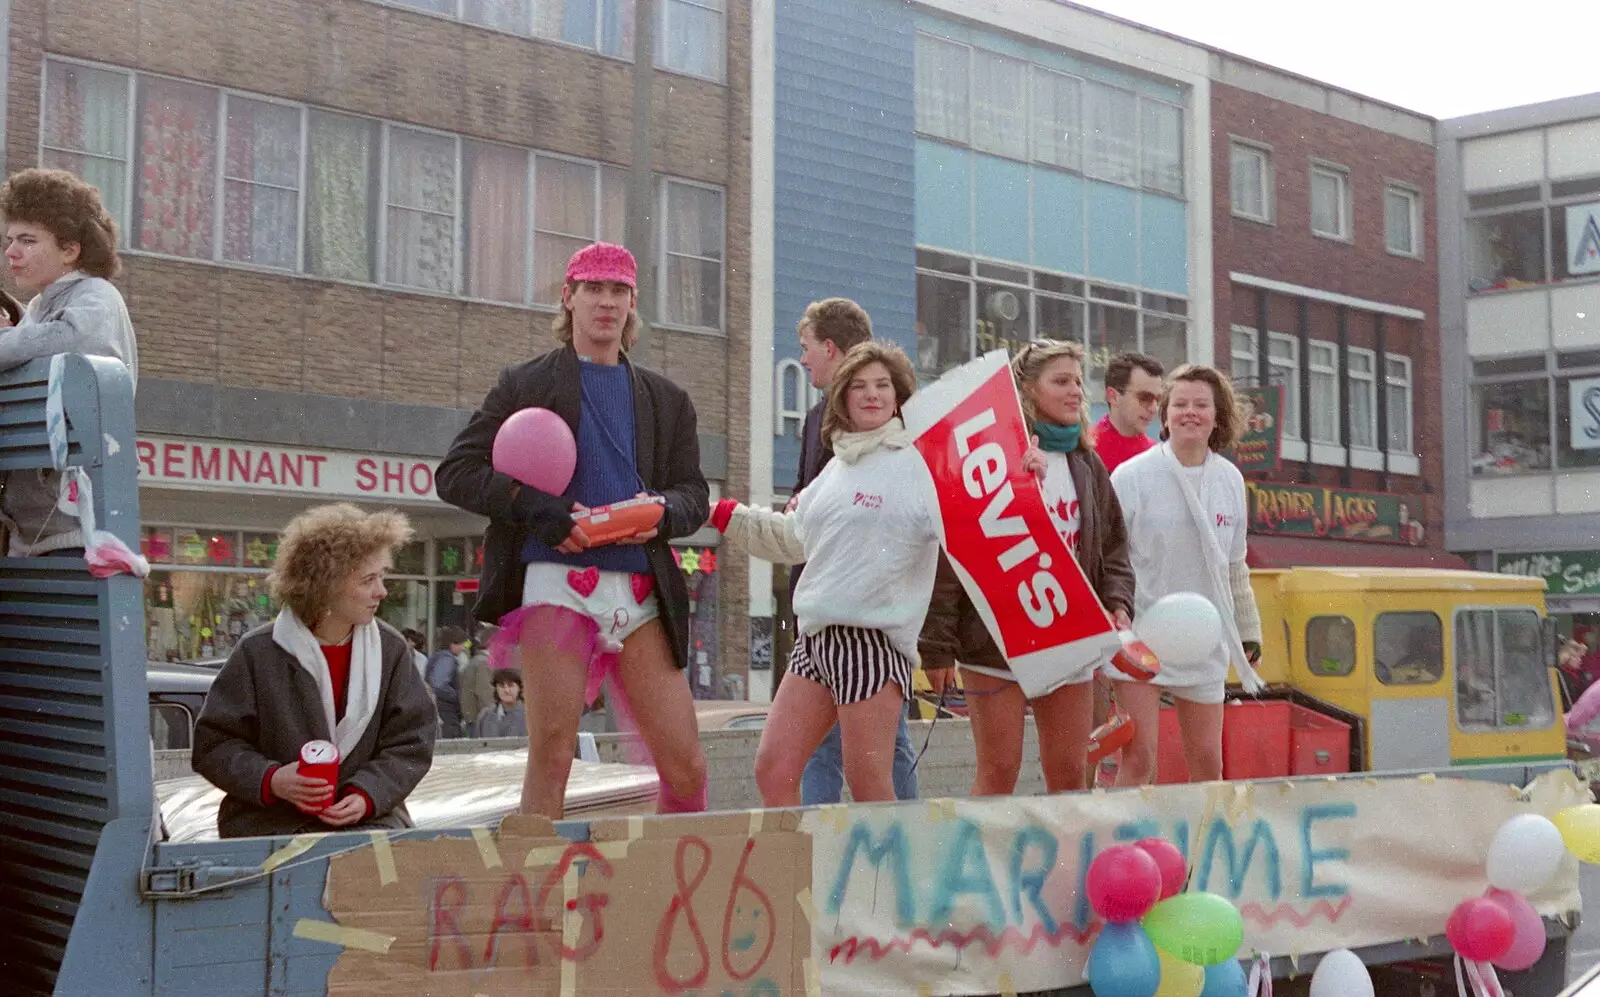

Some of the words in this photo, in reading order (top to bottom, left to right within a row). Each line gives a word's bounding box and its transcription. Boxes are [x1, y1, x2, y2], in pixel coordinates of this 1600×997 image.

[136, 440, 327, 487] REMNANT
[356, 458, 433, 496] SHO
[1563, 563, 1600, 593] Sa
[430, 842, 614, 972] RAG
[652, 835, 776, 993] 86
